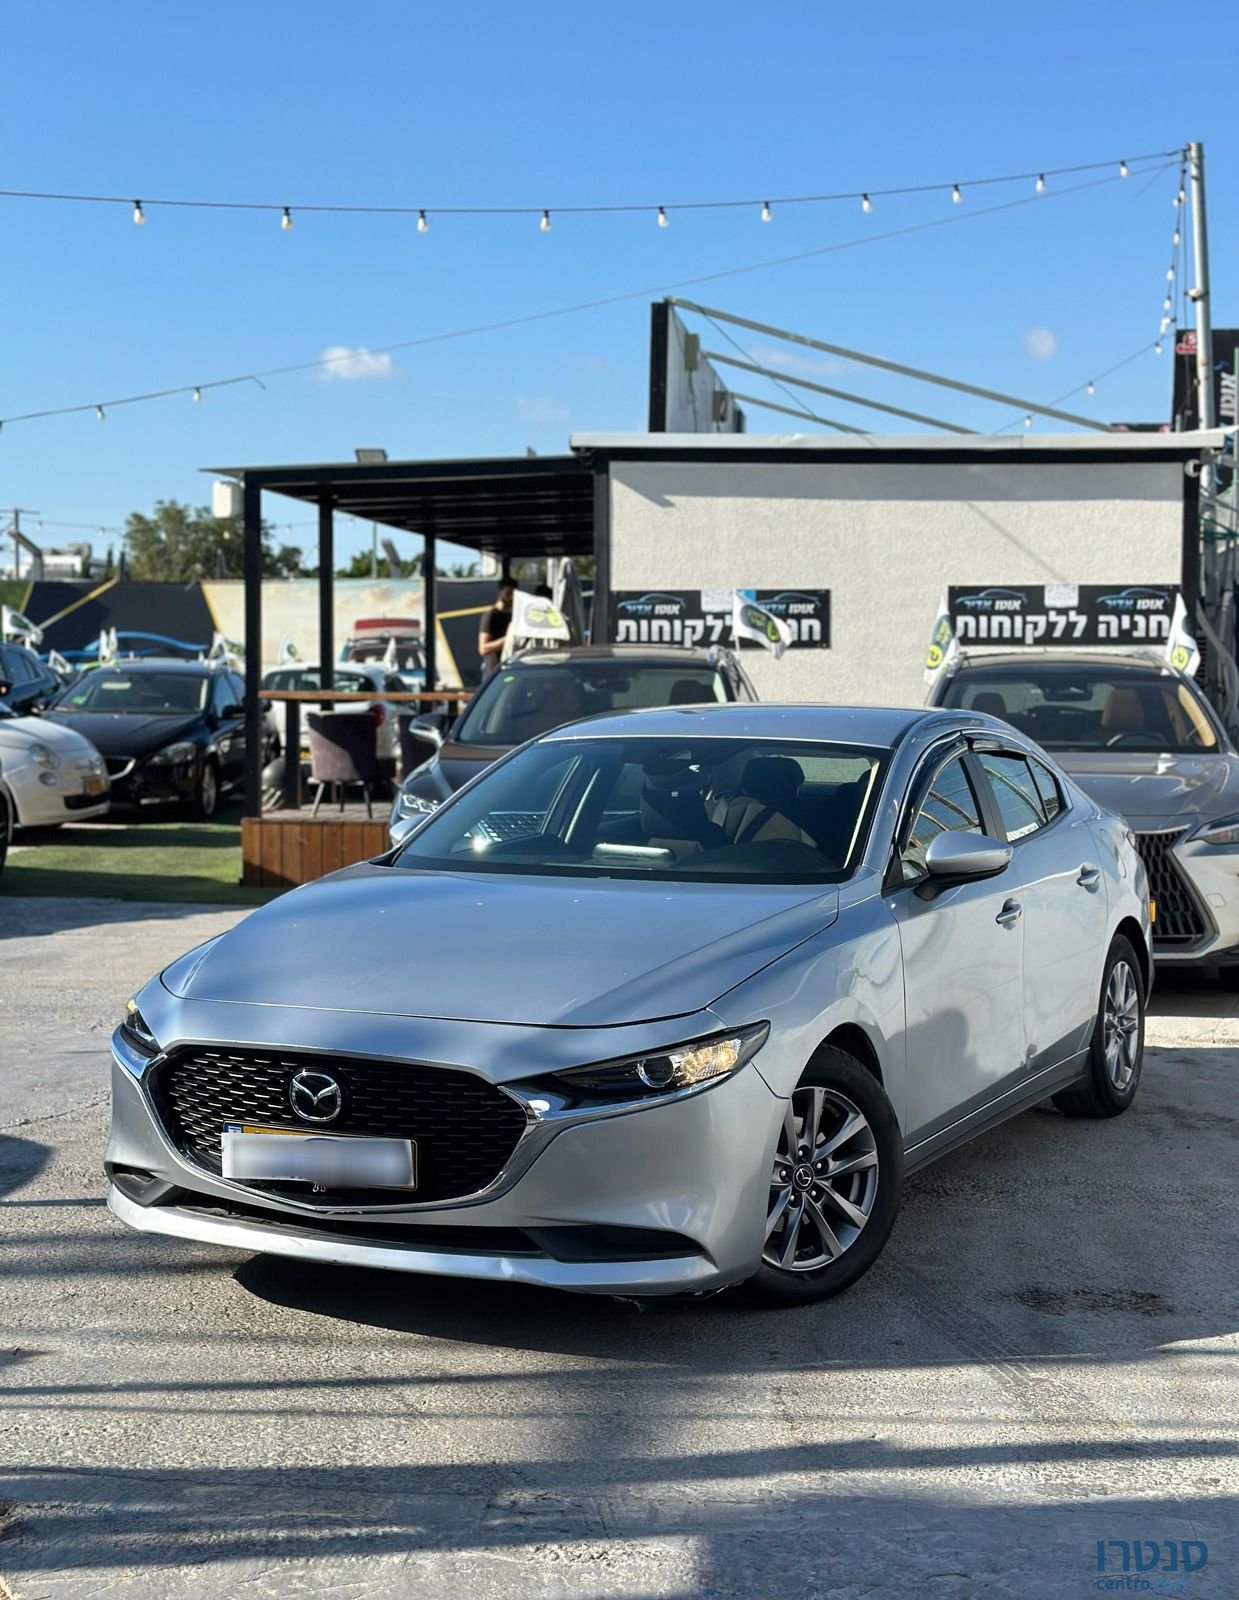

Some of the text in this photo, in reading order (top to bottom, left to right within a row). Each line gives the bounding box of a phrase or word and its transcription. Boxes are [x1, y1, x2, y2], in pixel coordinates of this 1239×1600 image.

[625, 604, 681, 615] אוטו אדיר
[788, 603, 815, 615] אוטו
[963, 599, 1022, 611] אוטו אדיר
[1105, 599, 1165, 610] אוטו אדיר
[955, 610, 1171, 645] חניה ללקוחות
